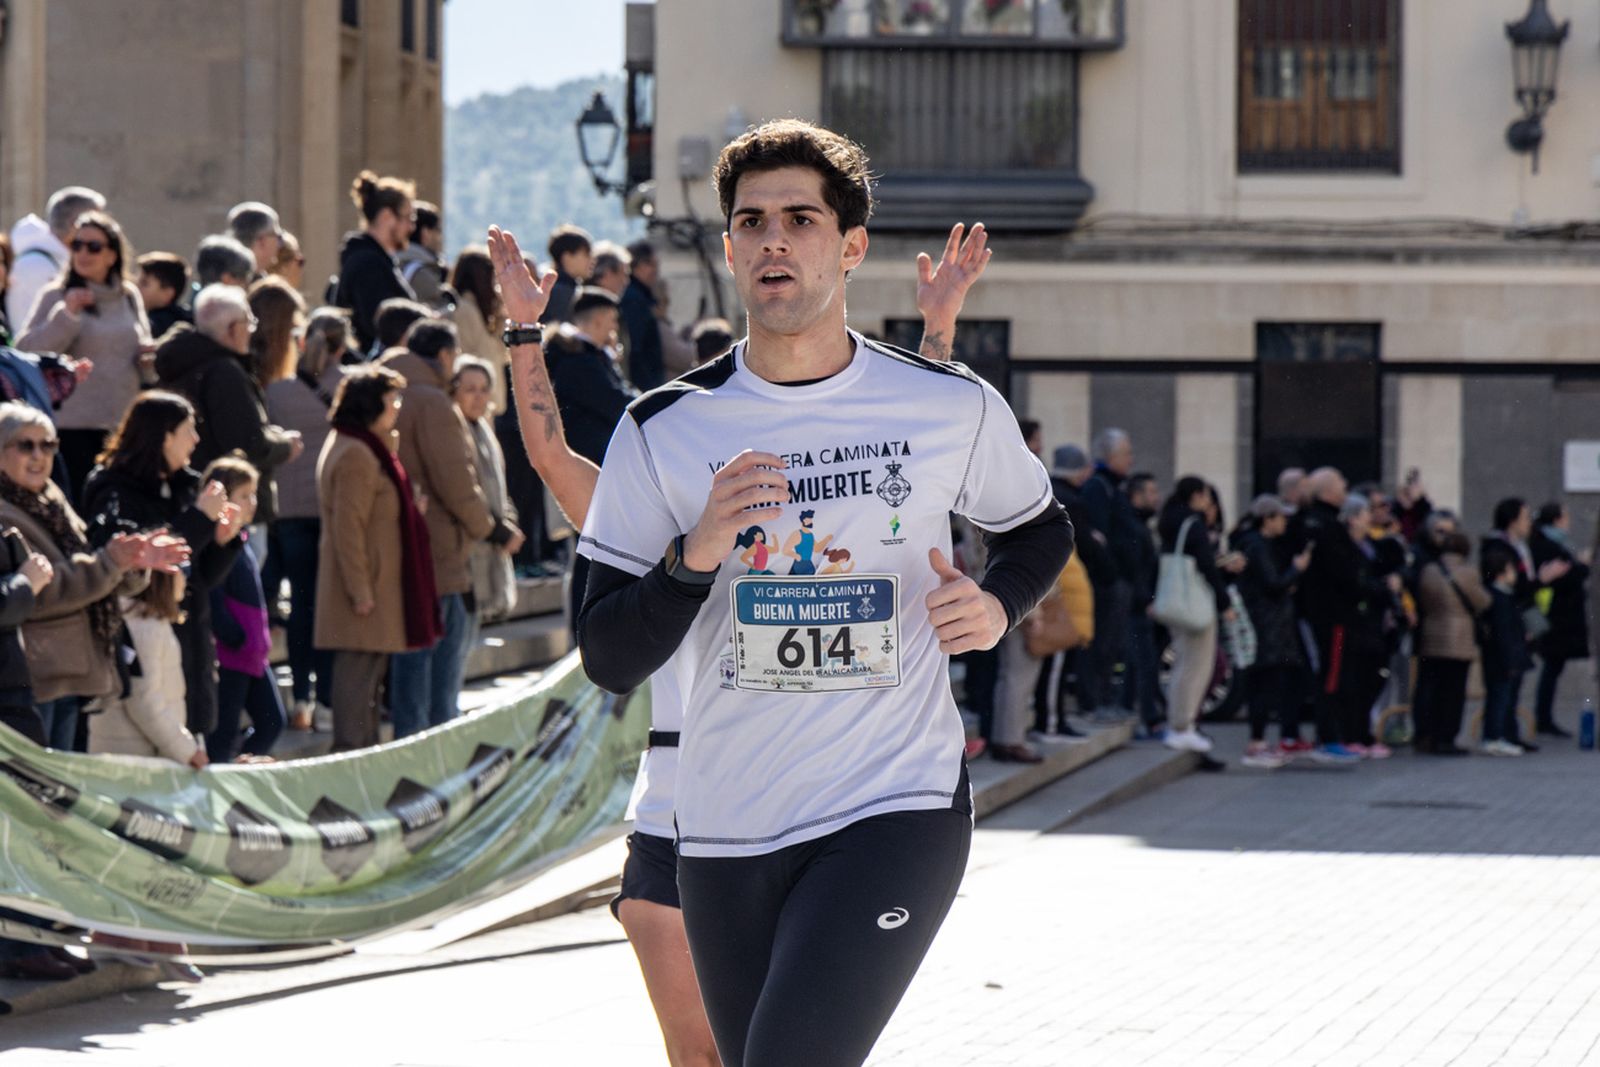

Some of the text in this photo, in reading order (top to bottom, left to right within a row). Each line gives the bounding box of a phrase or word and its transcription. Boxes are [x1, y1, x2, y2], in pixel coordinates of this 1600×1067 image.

[820, 440, 912, 465] CAMINATA
[787, 469, 873, 504] MUERTE
[753, 584, 876, 598] VI CARRERA CAMINATA
[753, 602, 851, 620] BUENA MUERTE
[777, 626, 855, 669] 614
[780, 669, 801, 677] ANGEL
[816, 668, 831, 676] REAL
